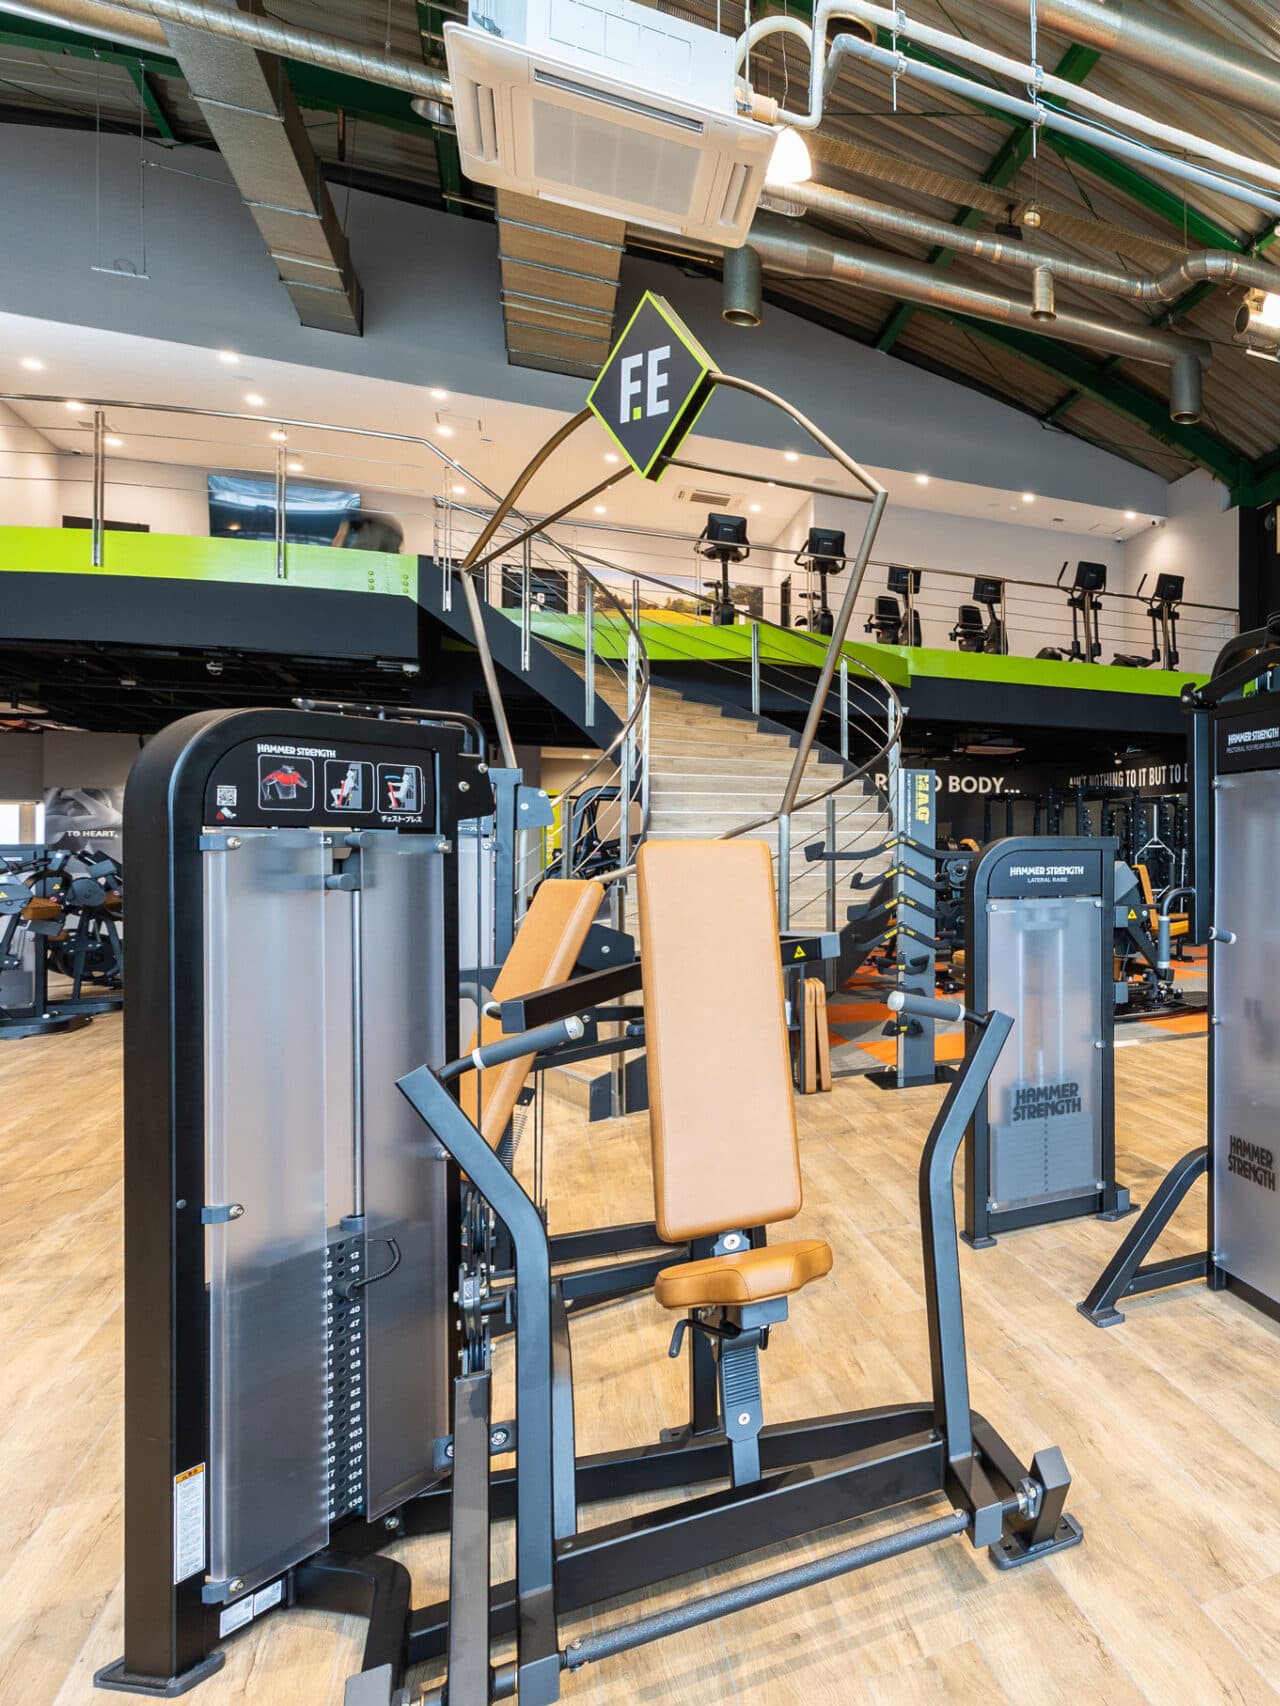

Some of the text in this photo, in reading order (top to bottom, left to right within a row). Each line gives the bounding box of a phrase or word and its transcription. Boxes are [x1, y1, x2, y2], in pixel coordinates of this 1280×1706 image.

[620, 345, 670, 424] F.E
[257, 743, 336, 758] HAMMER STRENGTH
[1089, 771, 1123, 787] NOTHING
[1126, 769, 1136, 787] TO
[1138, 768, 1147, 786] IT
[1149, 766, 1167, 786] BUT
[1169, 764, 1181, 784] TO
[949, 775, 1020, 793] BODY...
[67, 830, 80, 838] TO
[1010, 866, 1084, 876] HAMMER STRENGTH
[1016, 1082, 1079, 1105] HAMMER
[1013, 1097, 1081, 1121] STRENGTH
[1230, 1135, 1273, 1170] HAMMER
[1228, 1154, 1276, 1192] STRENGTH
[350, 1251, 360, 1260] 12
[350, 1265, 360, 1273] 19
[350, 1305, 360, 1314] 40
[350, 1319, 360, 1328] 47
[350, 1332, 361, 1342] 54
[350, 1346, 360, 1356] 61
[350, 1360, 361, 1369] 68
[350, 1373, 360, 1383] 75
[350, 1387, 360, 1397] 82
[350, 1401, 360, 1410] 89
[350, 1414, 360, 1424] 96
[349, 1427, 363, 1439] 103
[349, 1441, 363, 1452] 110
[349, 1454, 362, 1466] 117
[348, 1468, 362, 1480] 124
[348, 1482, 362, 1495] 131
[348, 1496, 363, 1508] 138
